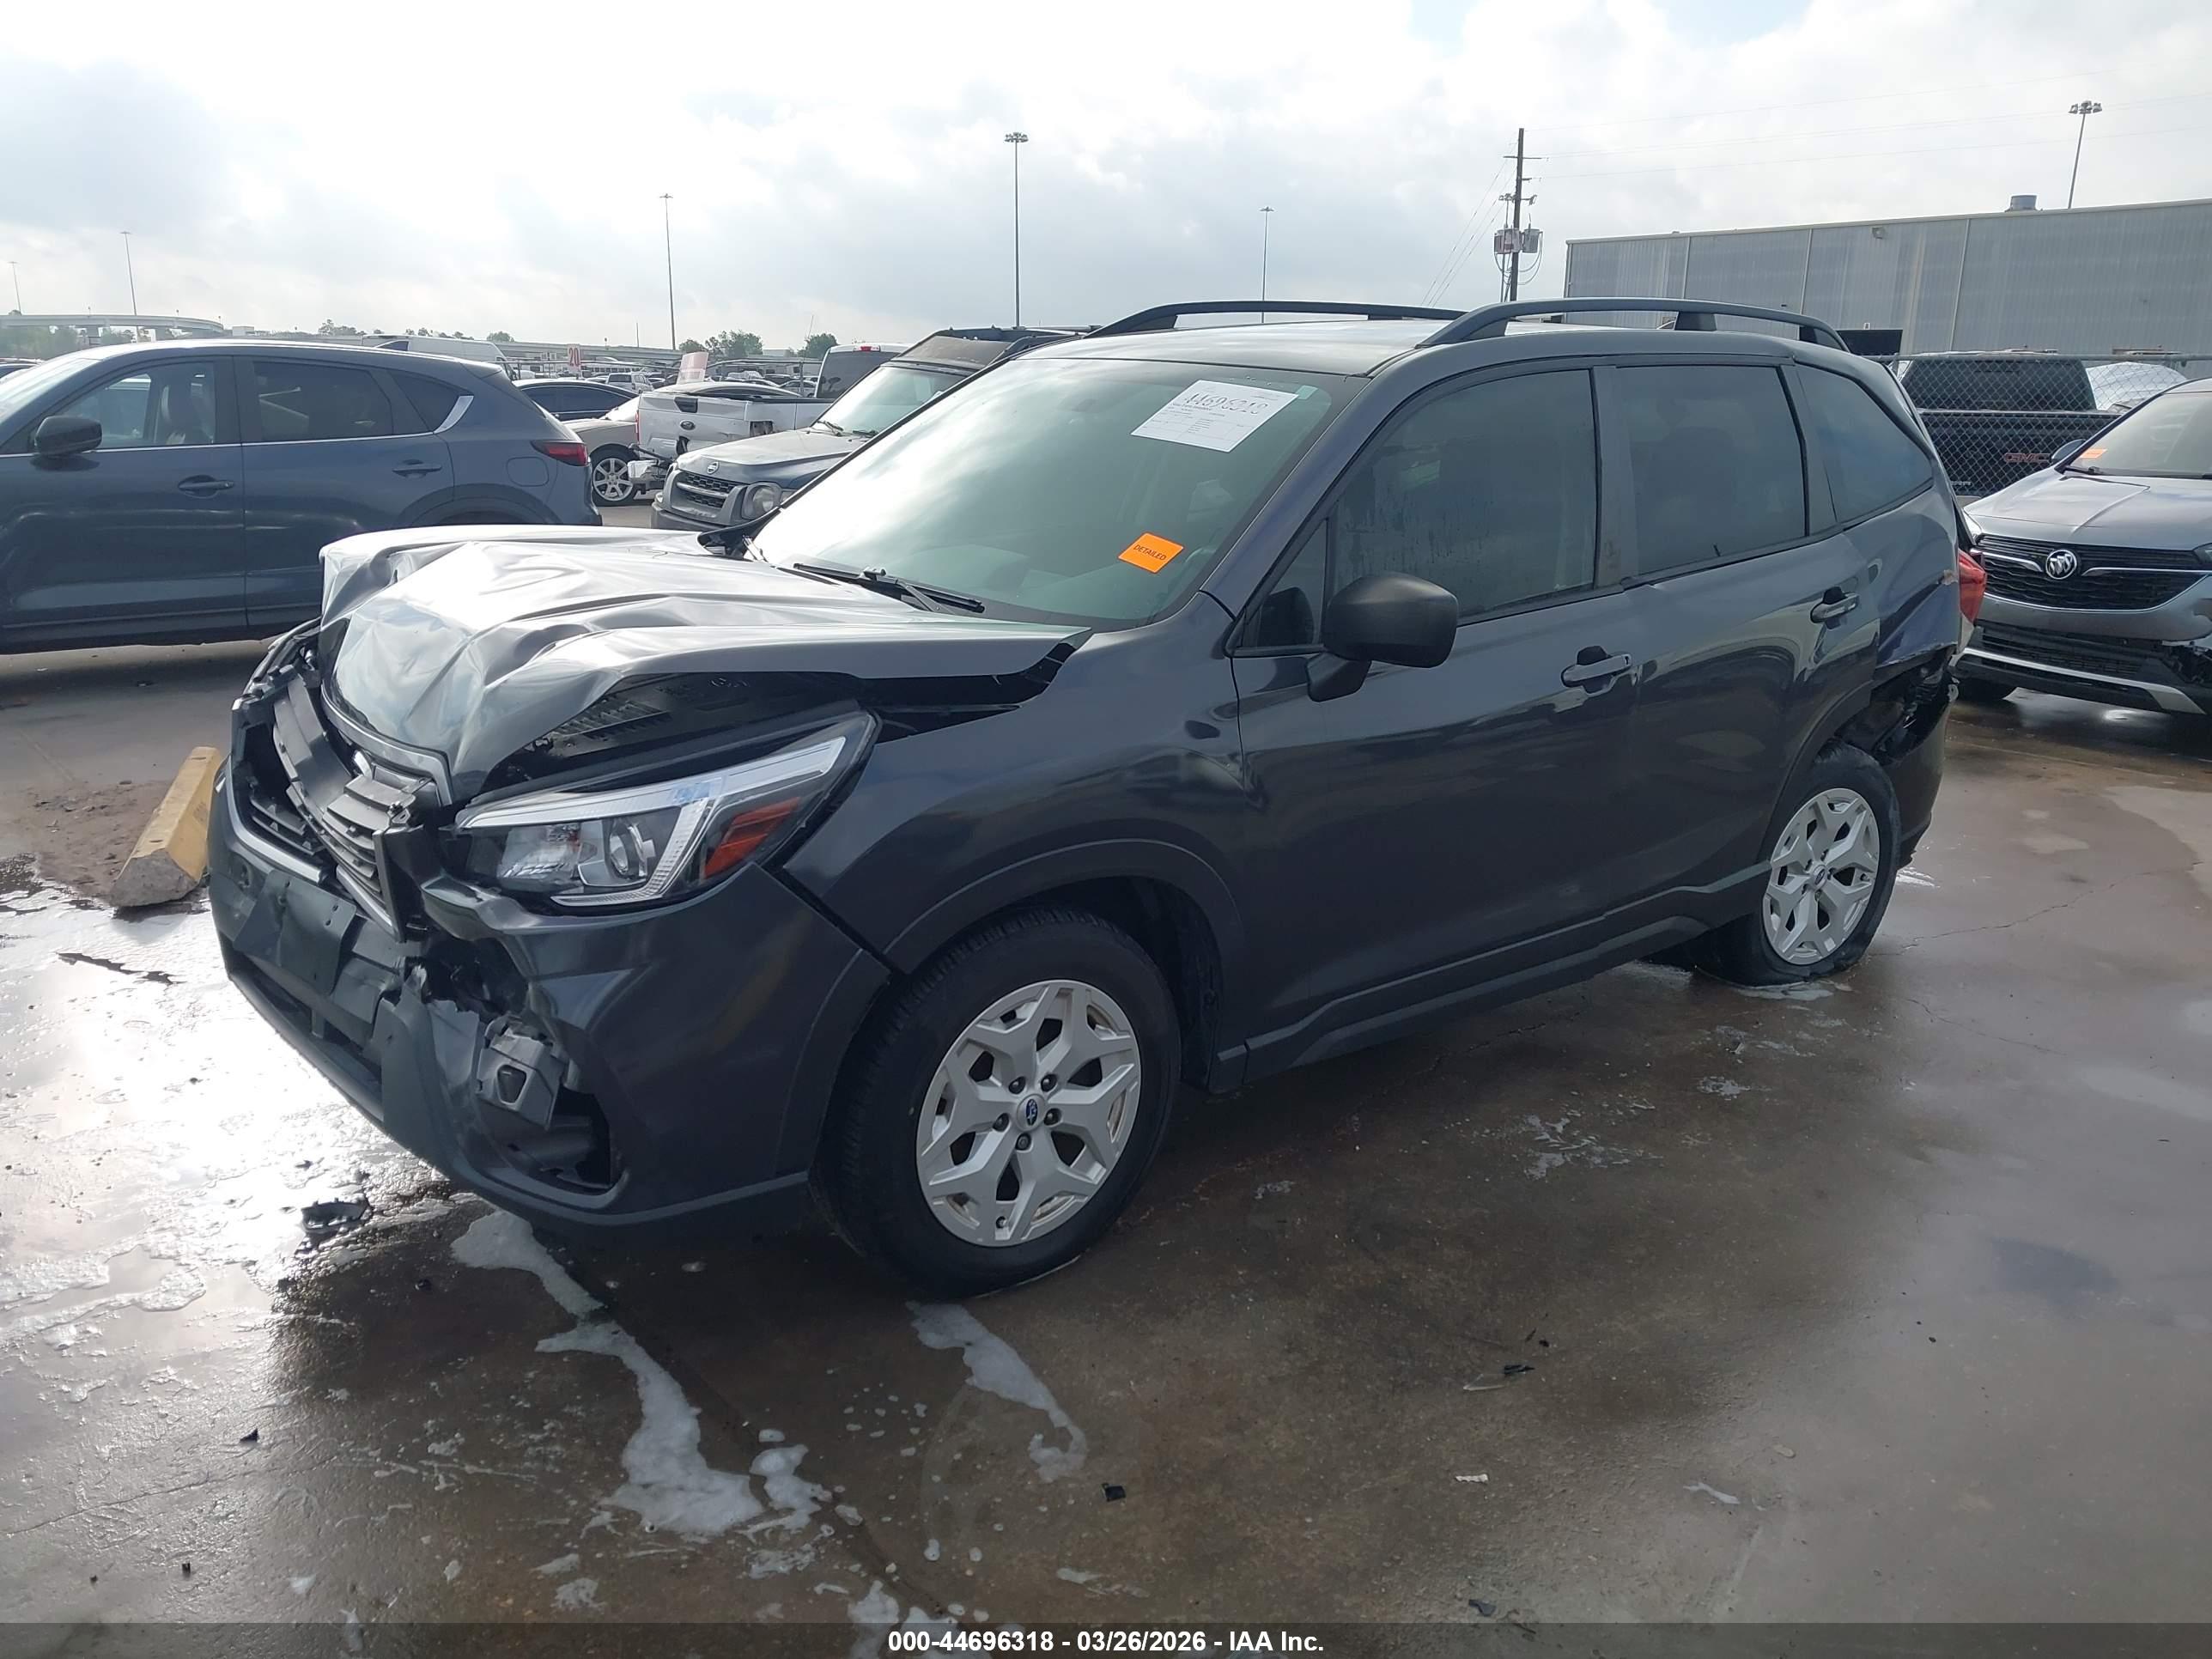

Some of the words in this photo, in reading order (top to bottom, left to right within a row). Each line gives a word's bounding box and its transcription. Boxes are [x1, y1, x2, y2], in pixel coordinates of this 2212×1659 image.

[568, 347, 580, 367] 20
[2004, 453, 2052, 464] GMC
[1133, 544, 1167, 561] DETAILED
